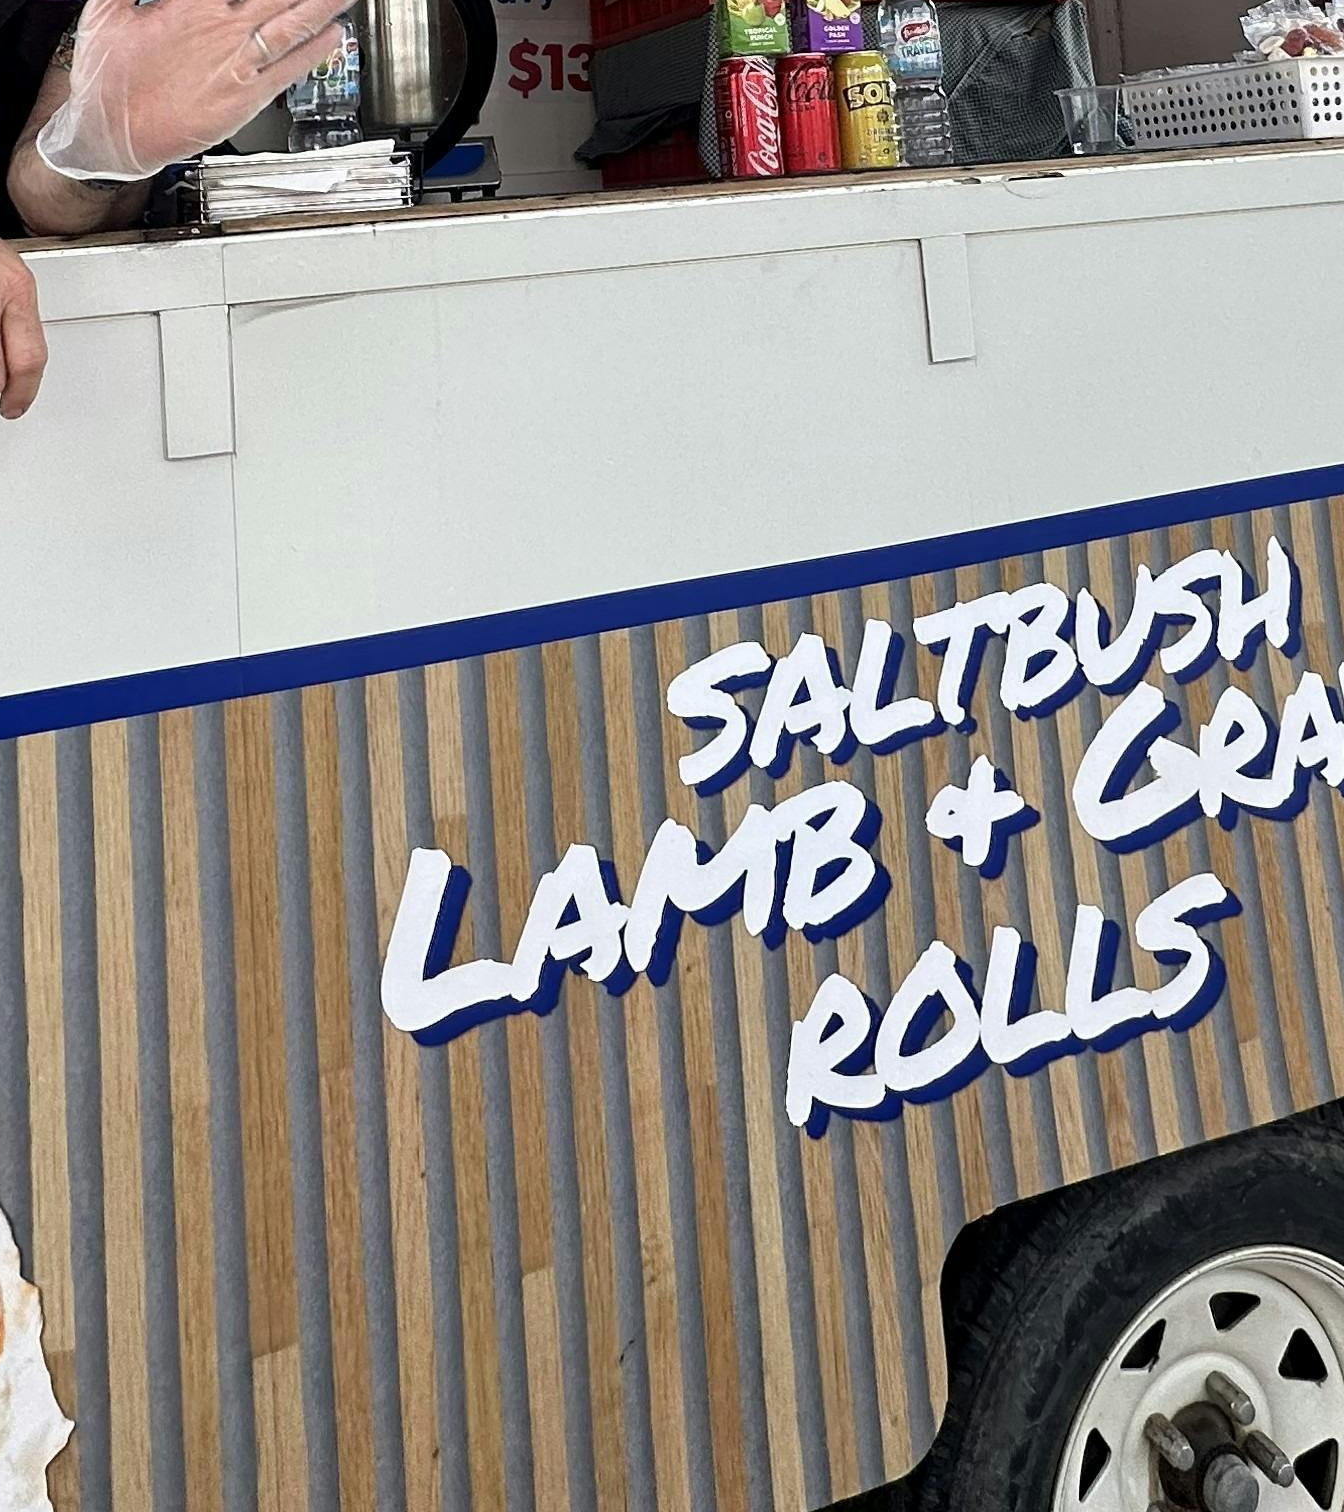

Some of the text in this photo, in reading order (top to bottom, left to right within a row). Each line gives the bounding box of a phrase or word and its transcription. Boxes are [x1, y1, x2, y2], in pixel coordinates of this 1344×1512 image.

[507, 38, 595, 99] $13
[666, 535, 1293, 788] SALTBUSH
[381, 780, 876, 1033] LAMB
[786, 872, 1230, 1128] ROLLS
